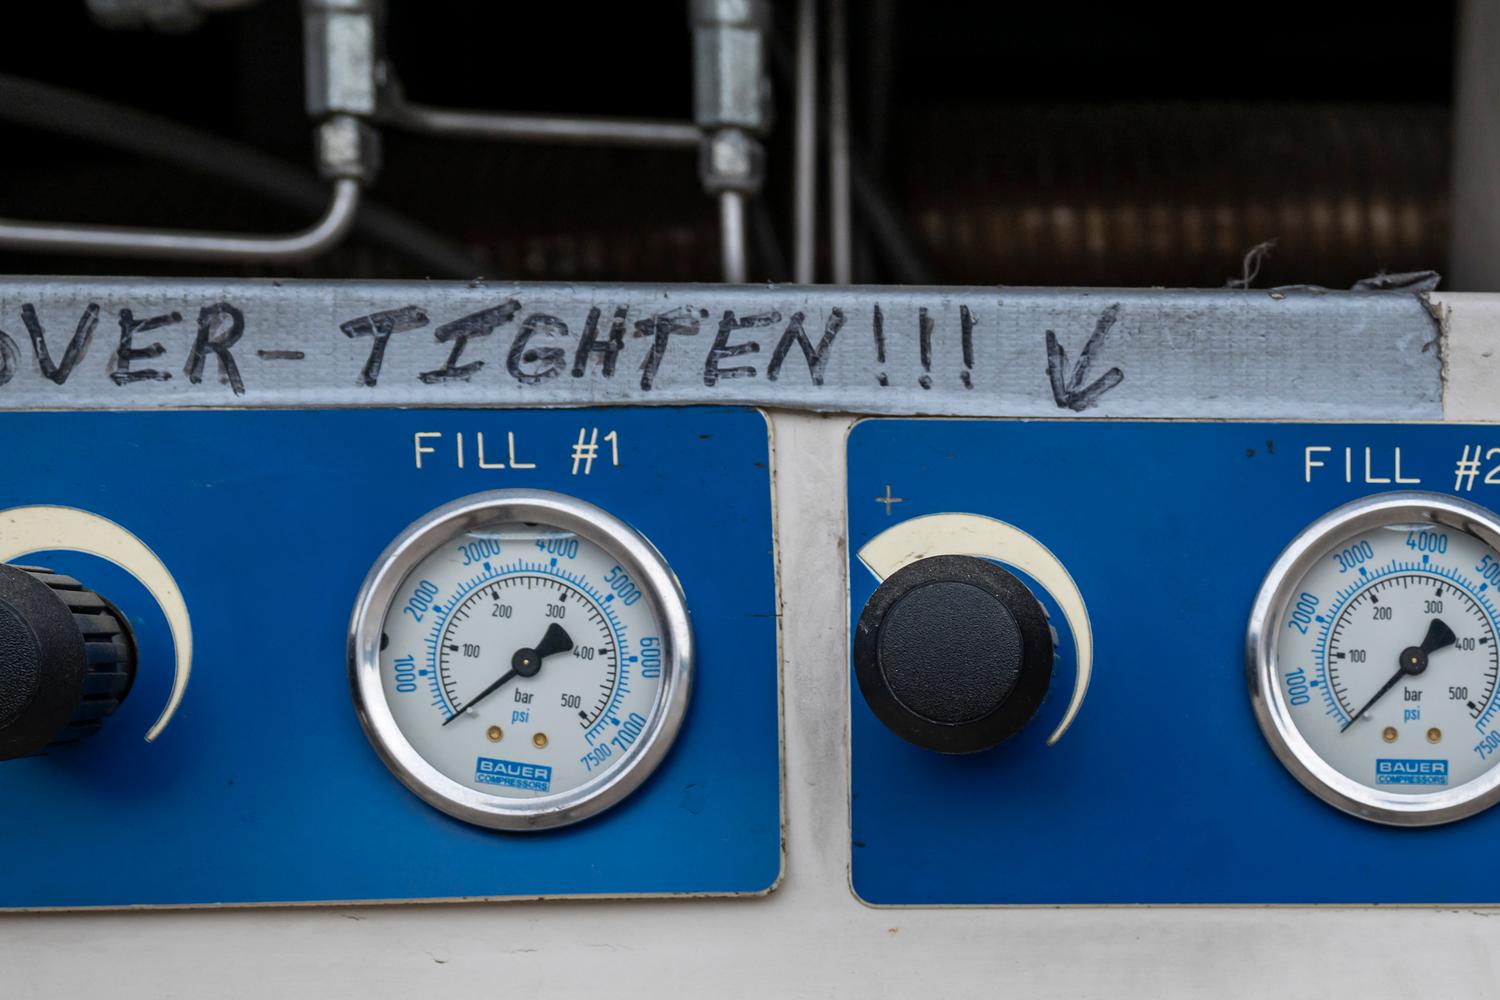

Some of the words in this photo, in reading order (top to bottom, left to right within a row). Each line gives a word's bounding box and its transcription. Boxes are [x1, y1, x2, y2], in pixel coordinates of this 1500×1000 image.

[414, 431, 536, 468] FILL
[571, 428, 619, 475] #1
[1305, 447, 1421, 483] FILL
[1406, 530, 1448, 554] 4000
[458, 539, 501, 566] 3000
[1333, 540, 1374, 573] 3000
[604, 565, 642, 607] 5000
[404, 580, 439, 622] 2000
[1424, 601, 1443, 614] 300
[492, 604, 512, 619] 200
[545, 604, 565, 619] 300
[1288, 593, 1319, 635] 2000
[1373, 607, 1392, 620] 200
[463, 644, 480, 658] 100
[1455, 637, 1475, 650] 400
[573, 646, 594, 660] 400
[640, 636, 661, 679] 6000
[1349, 650, 1366, 662] 100
[394, 655, 417, 692] 1000
[1285, 667, 1310, 706] 1000
[1404, 688, 1422, 701] bar
[1449, 687, 1468, 700] 500
[515, 688, 534, 704] bar
[561, 694, 581, 708] 500
[512, 708, 529, 724] psi
[1404, 708, 1420, 723] psi
[611, 712, 646, 752] 7000
[580, 744, 612, 772] 7500
[480, 761, 548, 779] BAUER
[1380, 762, 1444, 772] BAUER
